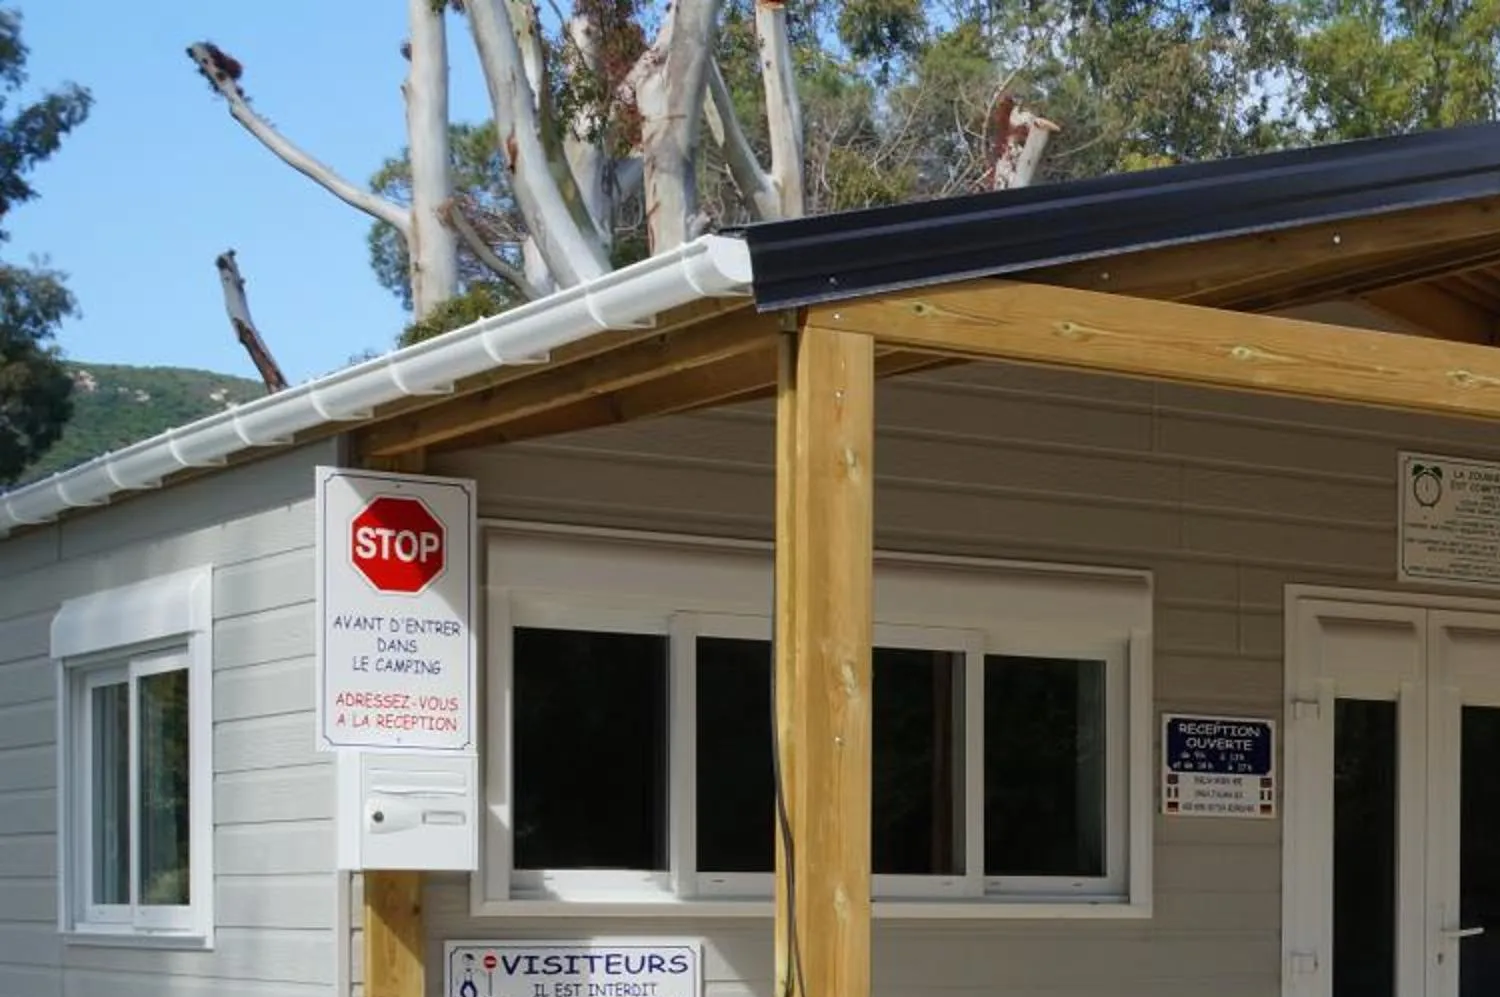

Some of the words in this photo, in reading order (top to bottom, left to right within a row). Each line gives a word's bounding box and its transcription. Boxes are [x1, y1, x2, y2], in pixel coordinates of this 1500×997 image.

[355, 526, 440, 563] STOP
[333, 614, 384, 632] AVANT
[389, 617, 461, 637] D'ENTRER
[376, 637, 418, 653] DANS
[352, 656, 369, 672] LE
[375, 657, 442, 675] CAMPING
[335, 692, 459, 712] ADRESSEZ-VOUS
[336, 713, 346, 727] A
[352, 715, 370, 728] LA
[376, 714, 457, 732] RECEPTION
[1179, 723, 1261, 737] RECEPTION
[1185, 737, 1253, 751] OUVERTE
[501, 954, 689, 976] VISITEURS
[587, 982, 657, 997] INTERDIT
